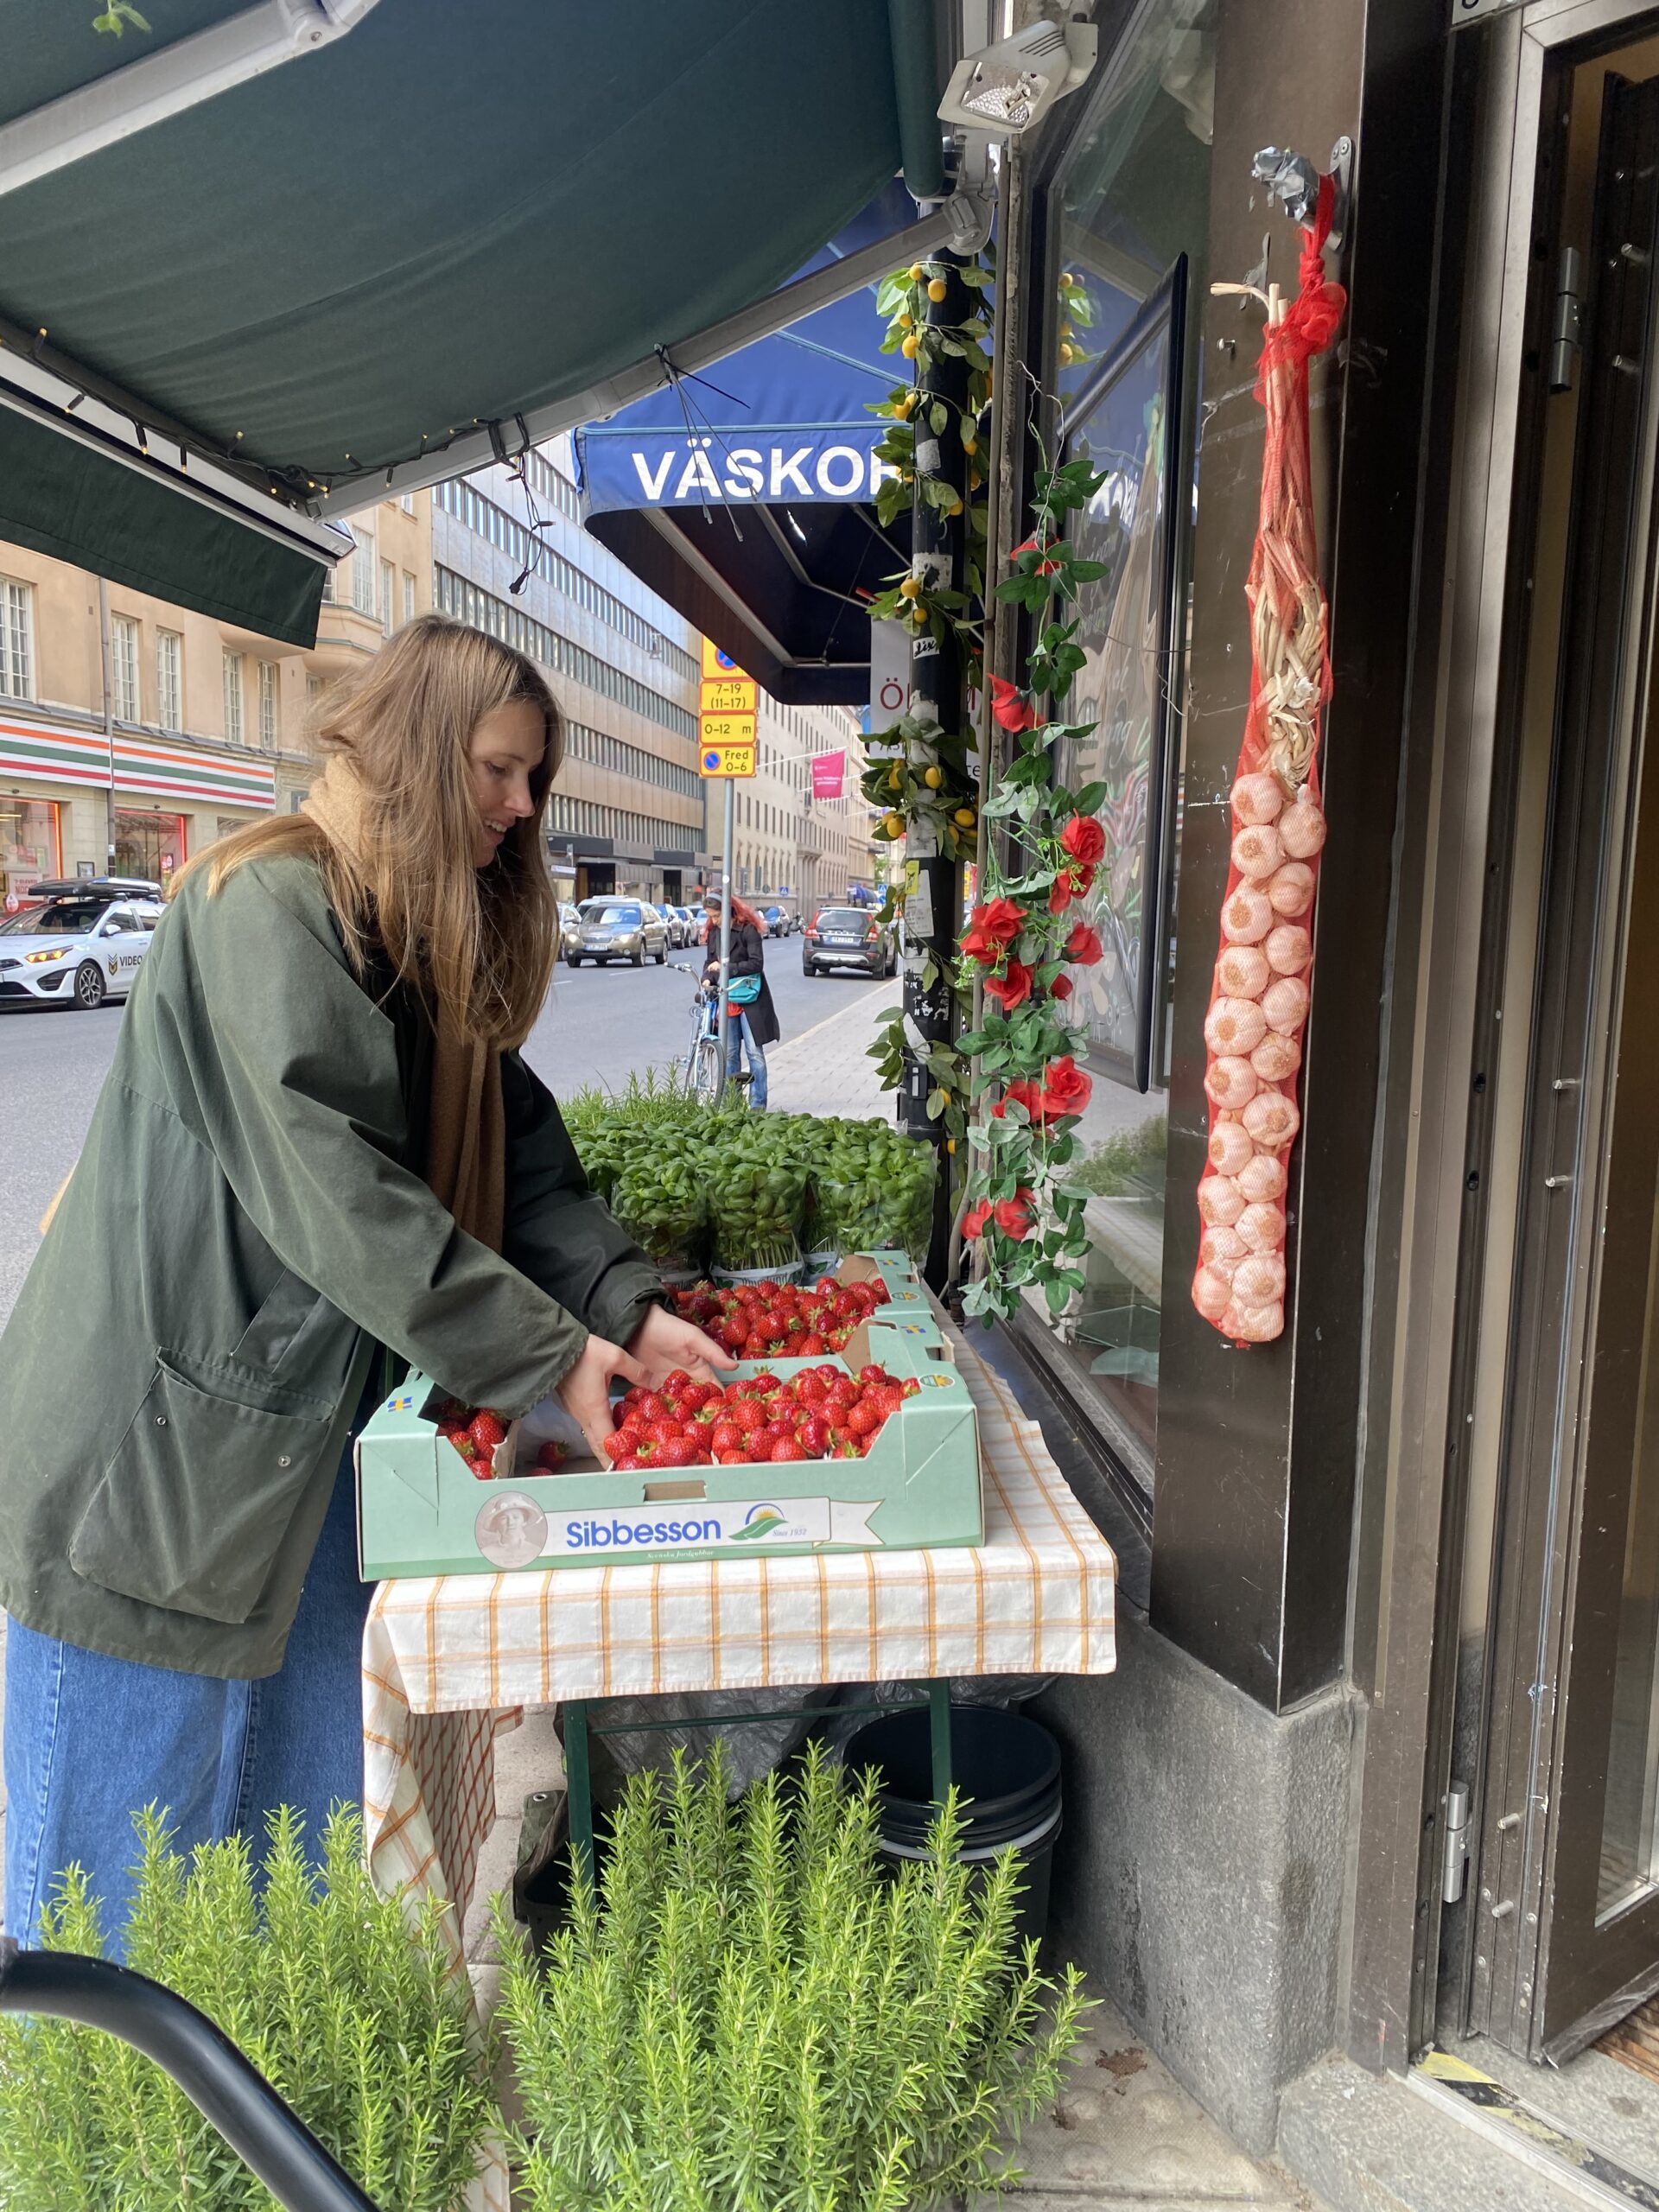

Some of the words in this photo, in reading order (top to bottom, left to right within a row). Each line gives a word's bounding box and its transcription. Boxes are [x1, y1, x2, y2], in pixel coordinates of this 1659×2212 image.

[716, 683, 741, 694] 7-19
[710, 696, 746, 709] (11-17)
[704, 724, 730, 734] 0-12
[725, 750, 748, 760] Fred
[726, 762, 747, 772] 0-6
[119, 955, 145, 966] VIDEO
[567, 1520, 721, 1548] Sibbesson
